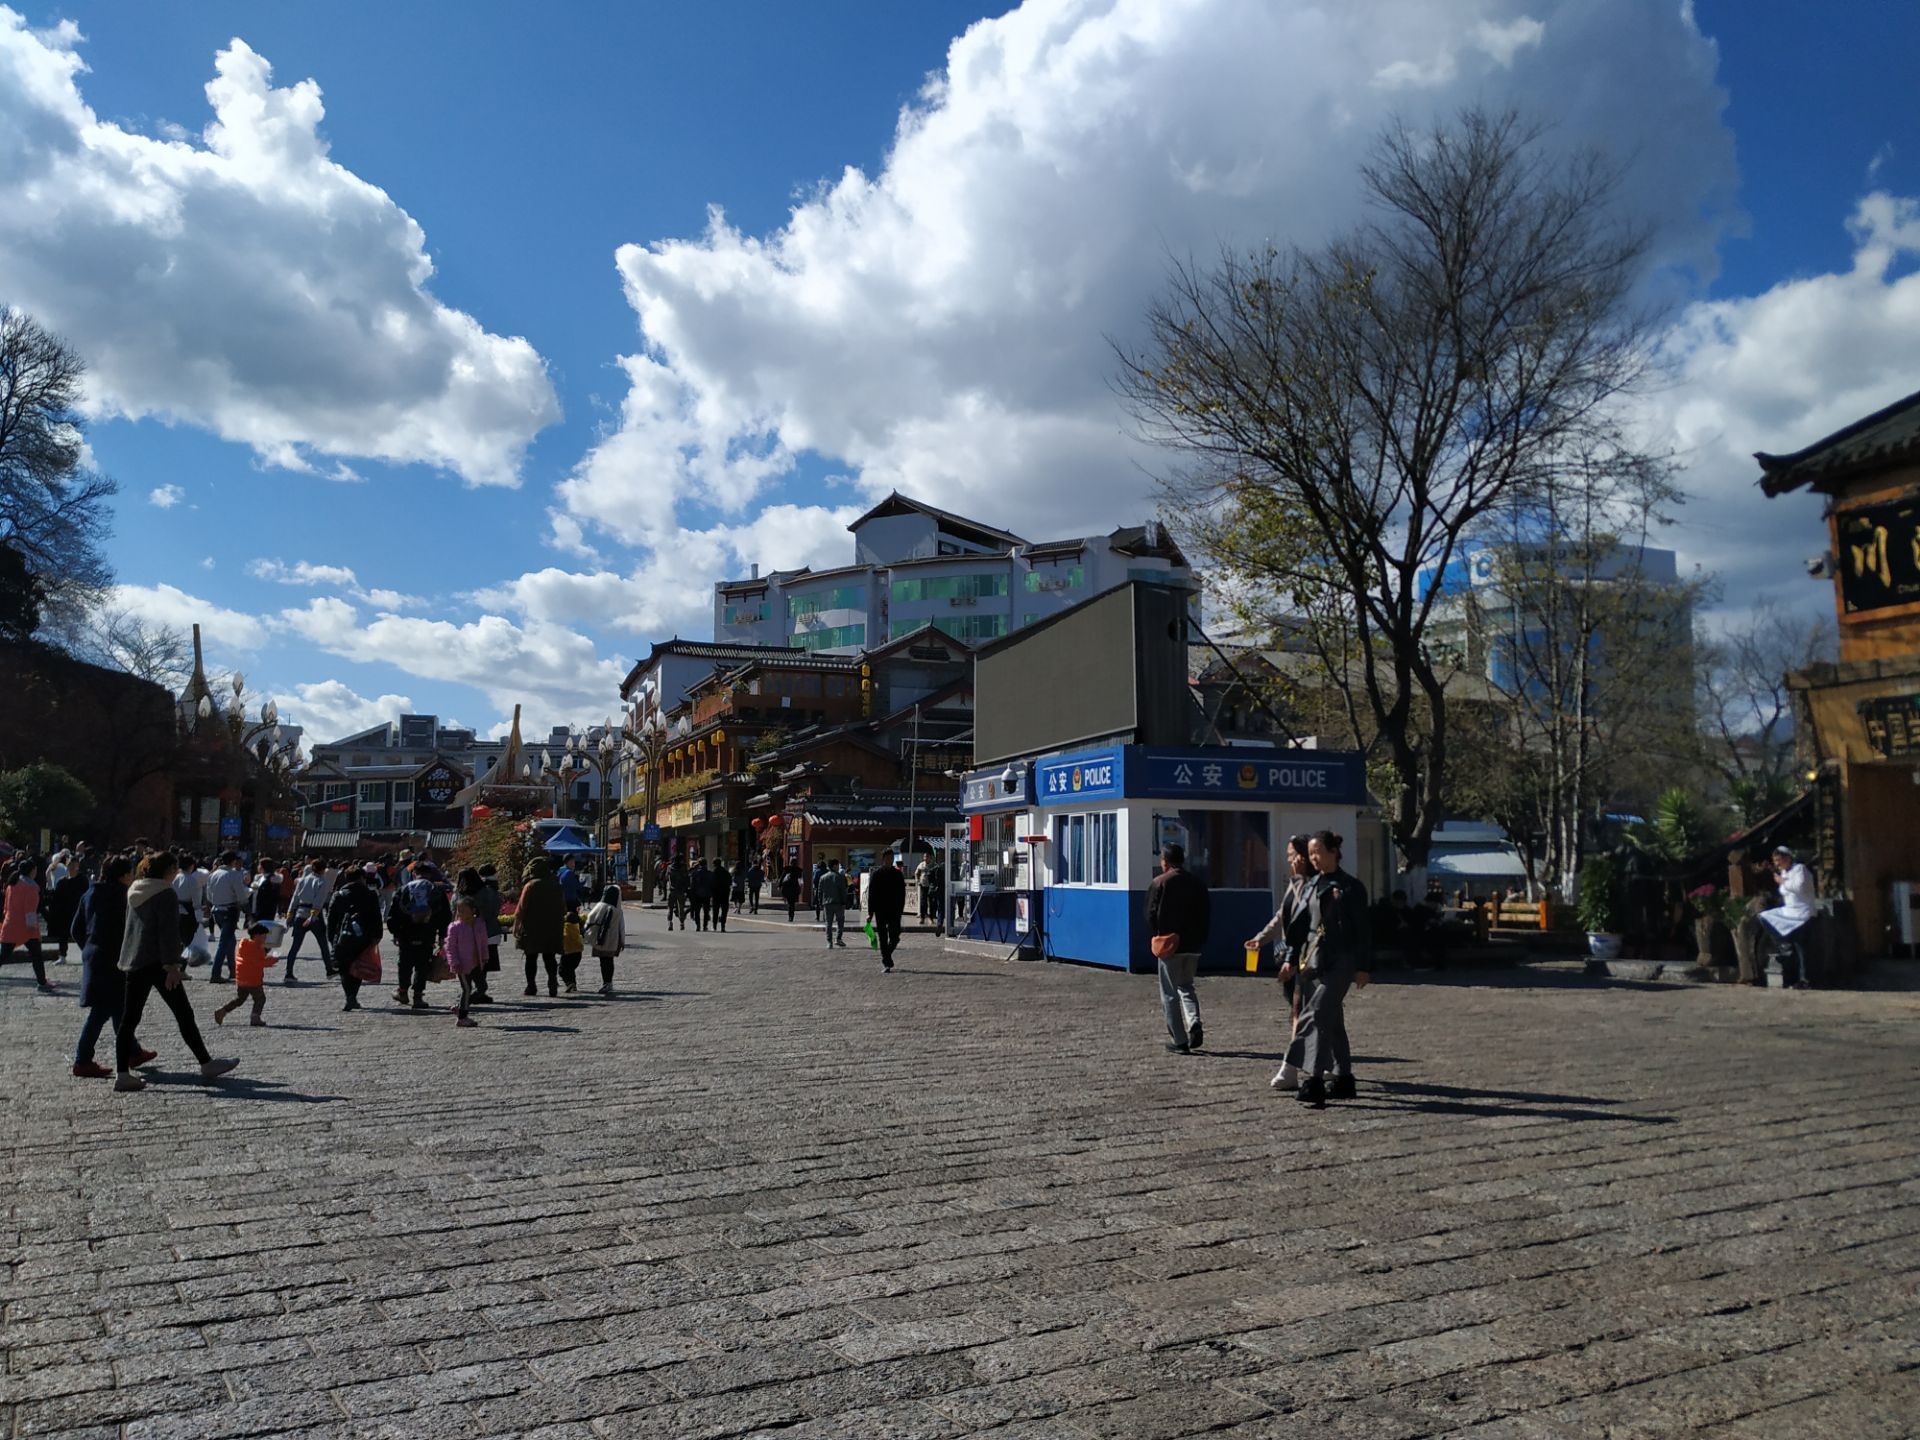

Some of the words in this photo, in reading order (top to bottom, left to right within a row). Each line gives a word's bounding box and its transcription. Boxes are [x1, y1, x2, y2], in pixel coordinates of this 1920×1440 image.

[1048, 771, 1068, 793] 公安
[1084, 765, 1112, 787] POLICE
[1173, 763, 1223, 787] 公安
[1268, 768, 1328, 788] POLICE
[969, 783, 984, 800] 公安
